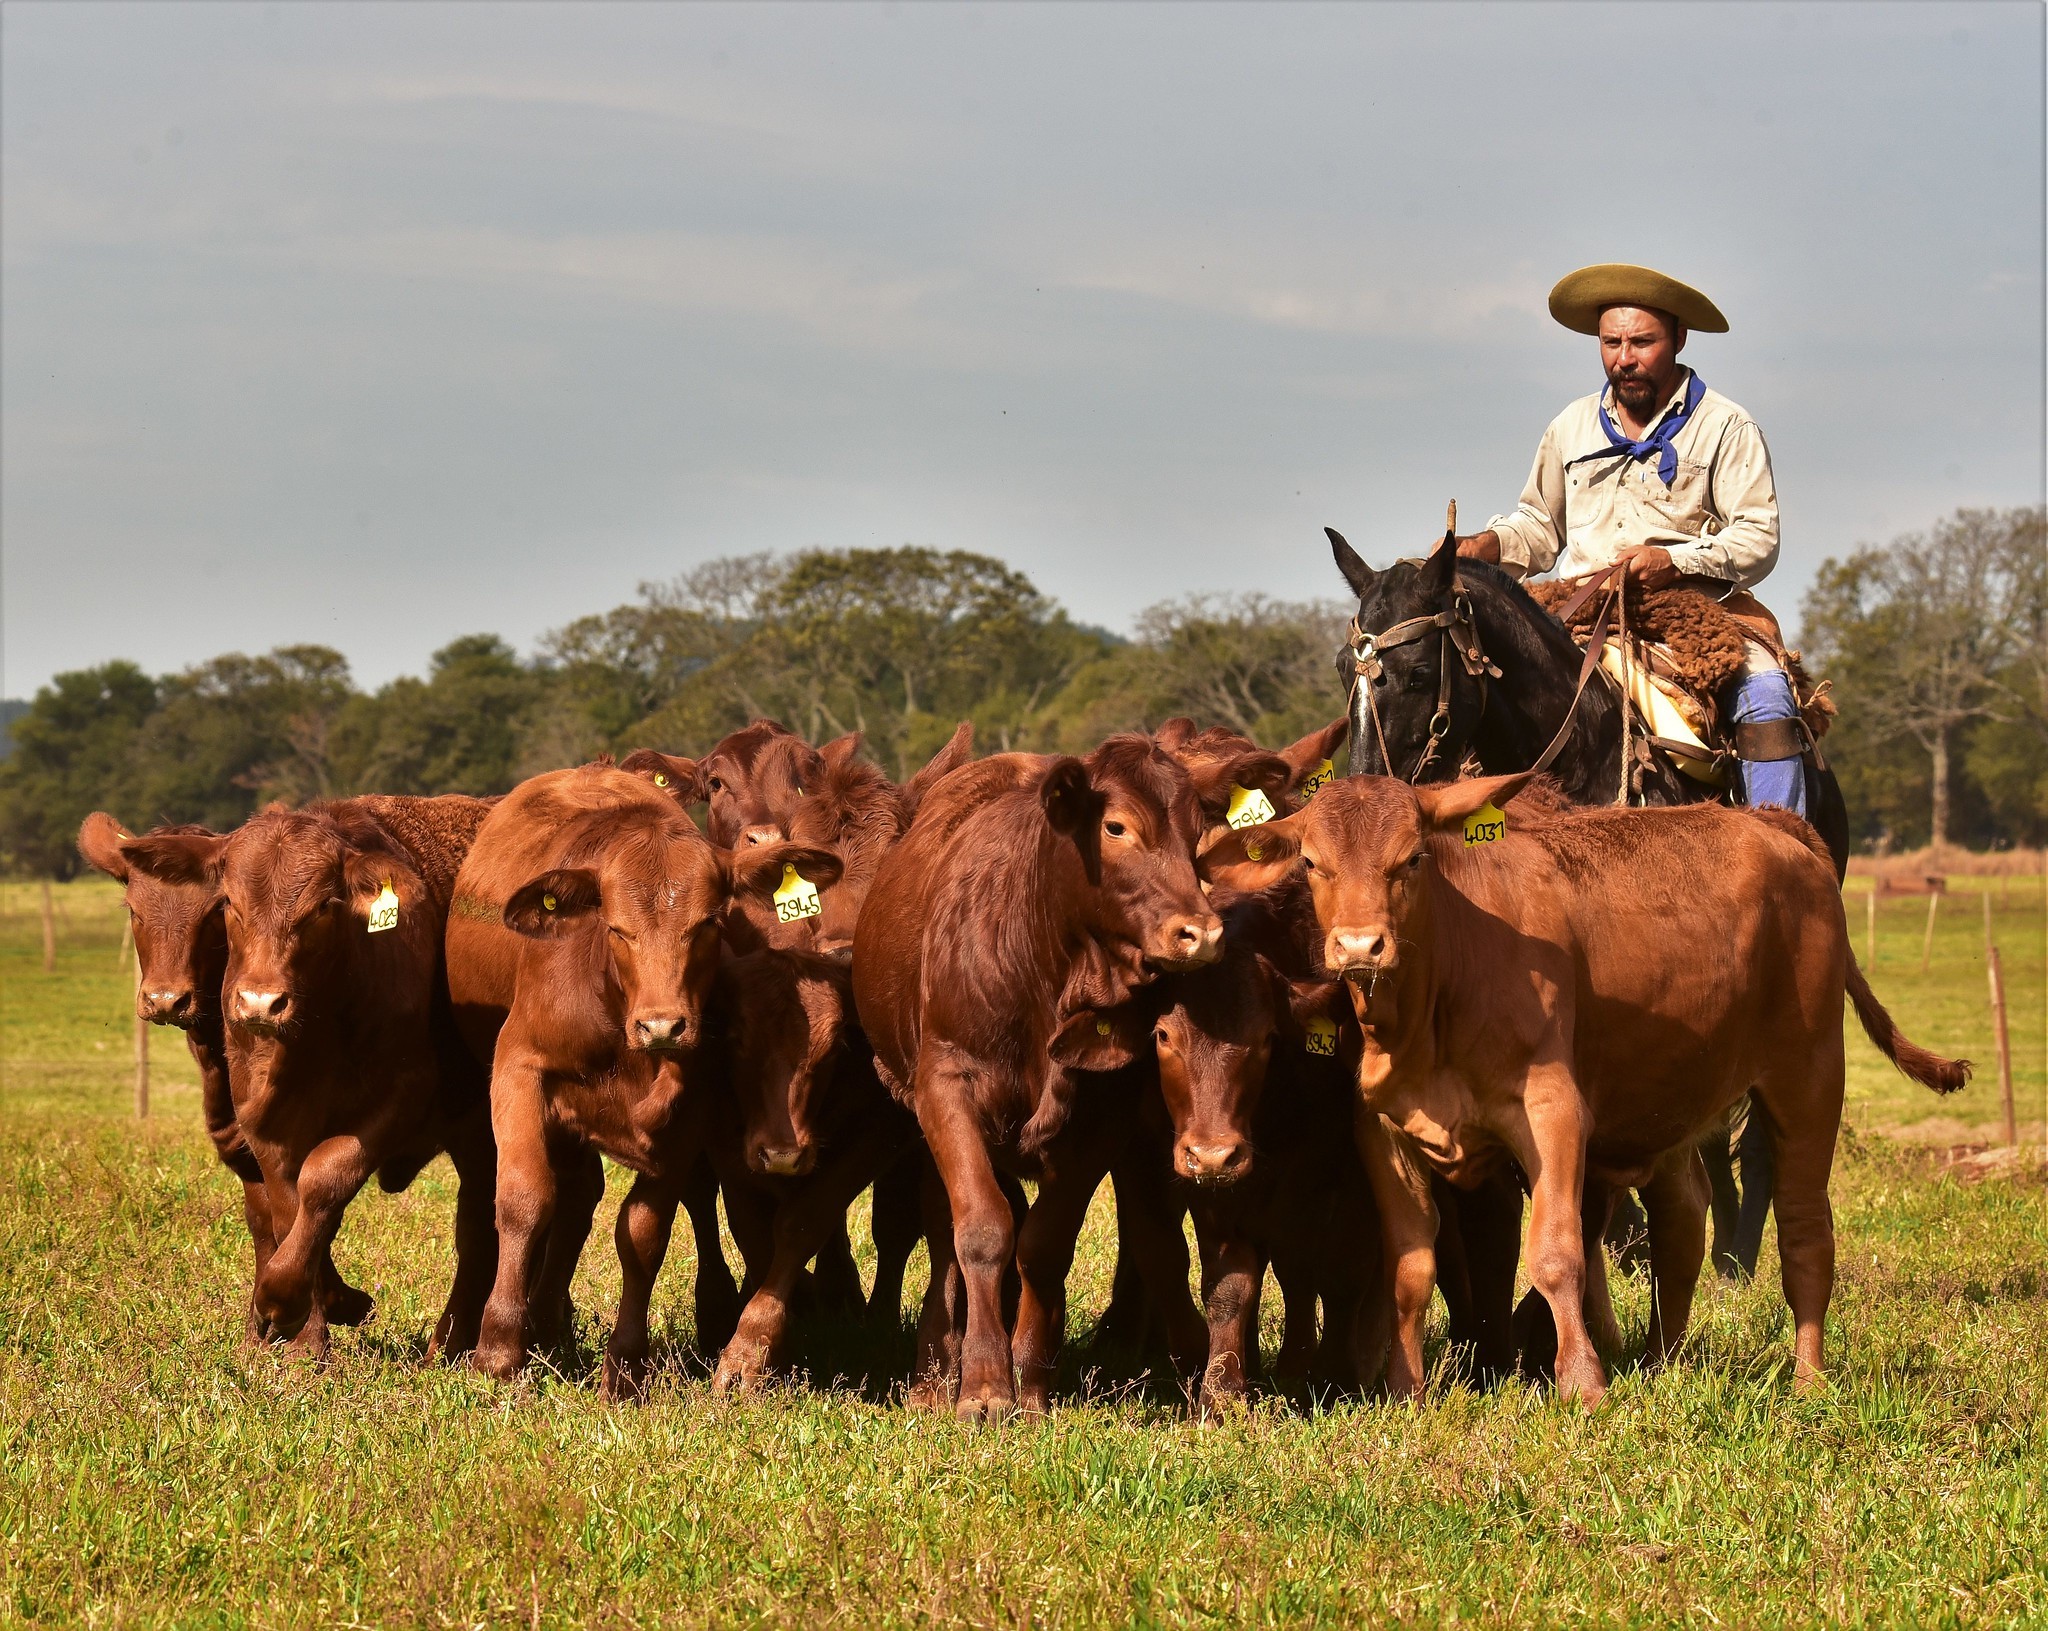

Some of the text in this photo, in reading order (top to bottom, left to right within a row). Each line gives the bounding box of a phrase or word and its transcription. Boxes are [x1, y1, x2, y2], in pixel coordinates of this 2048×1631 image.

[1464, 820, 1505, 845] 4031
[370, 907, 398, 929] 4029
[776, 893, 820, 922] 3945
[1306, 1031, 1336, 1055] 3943
